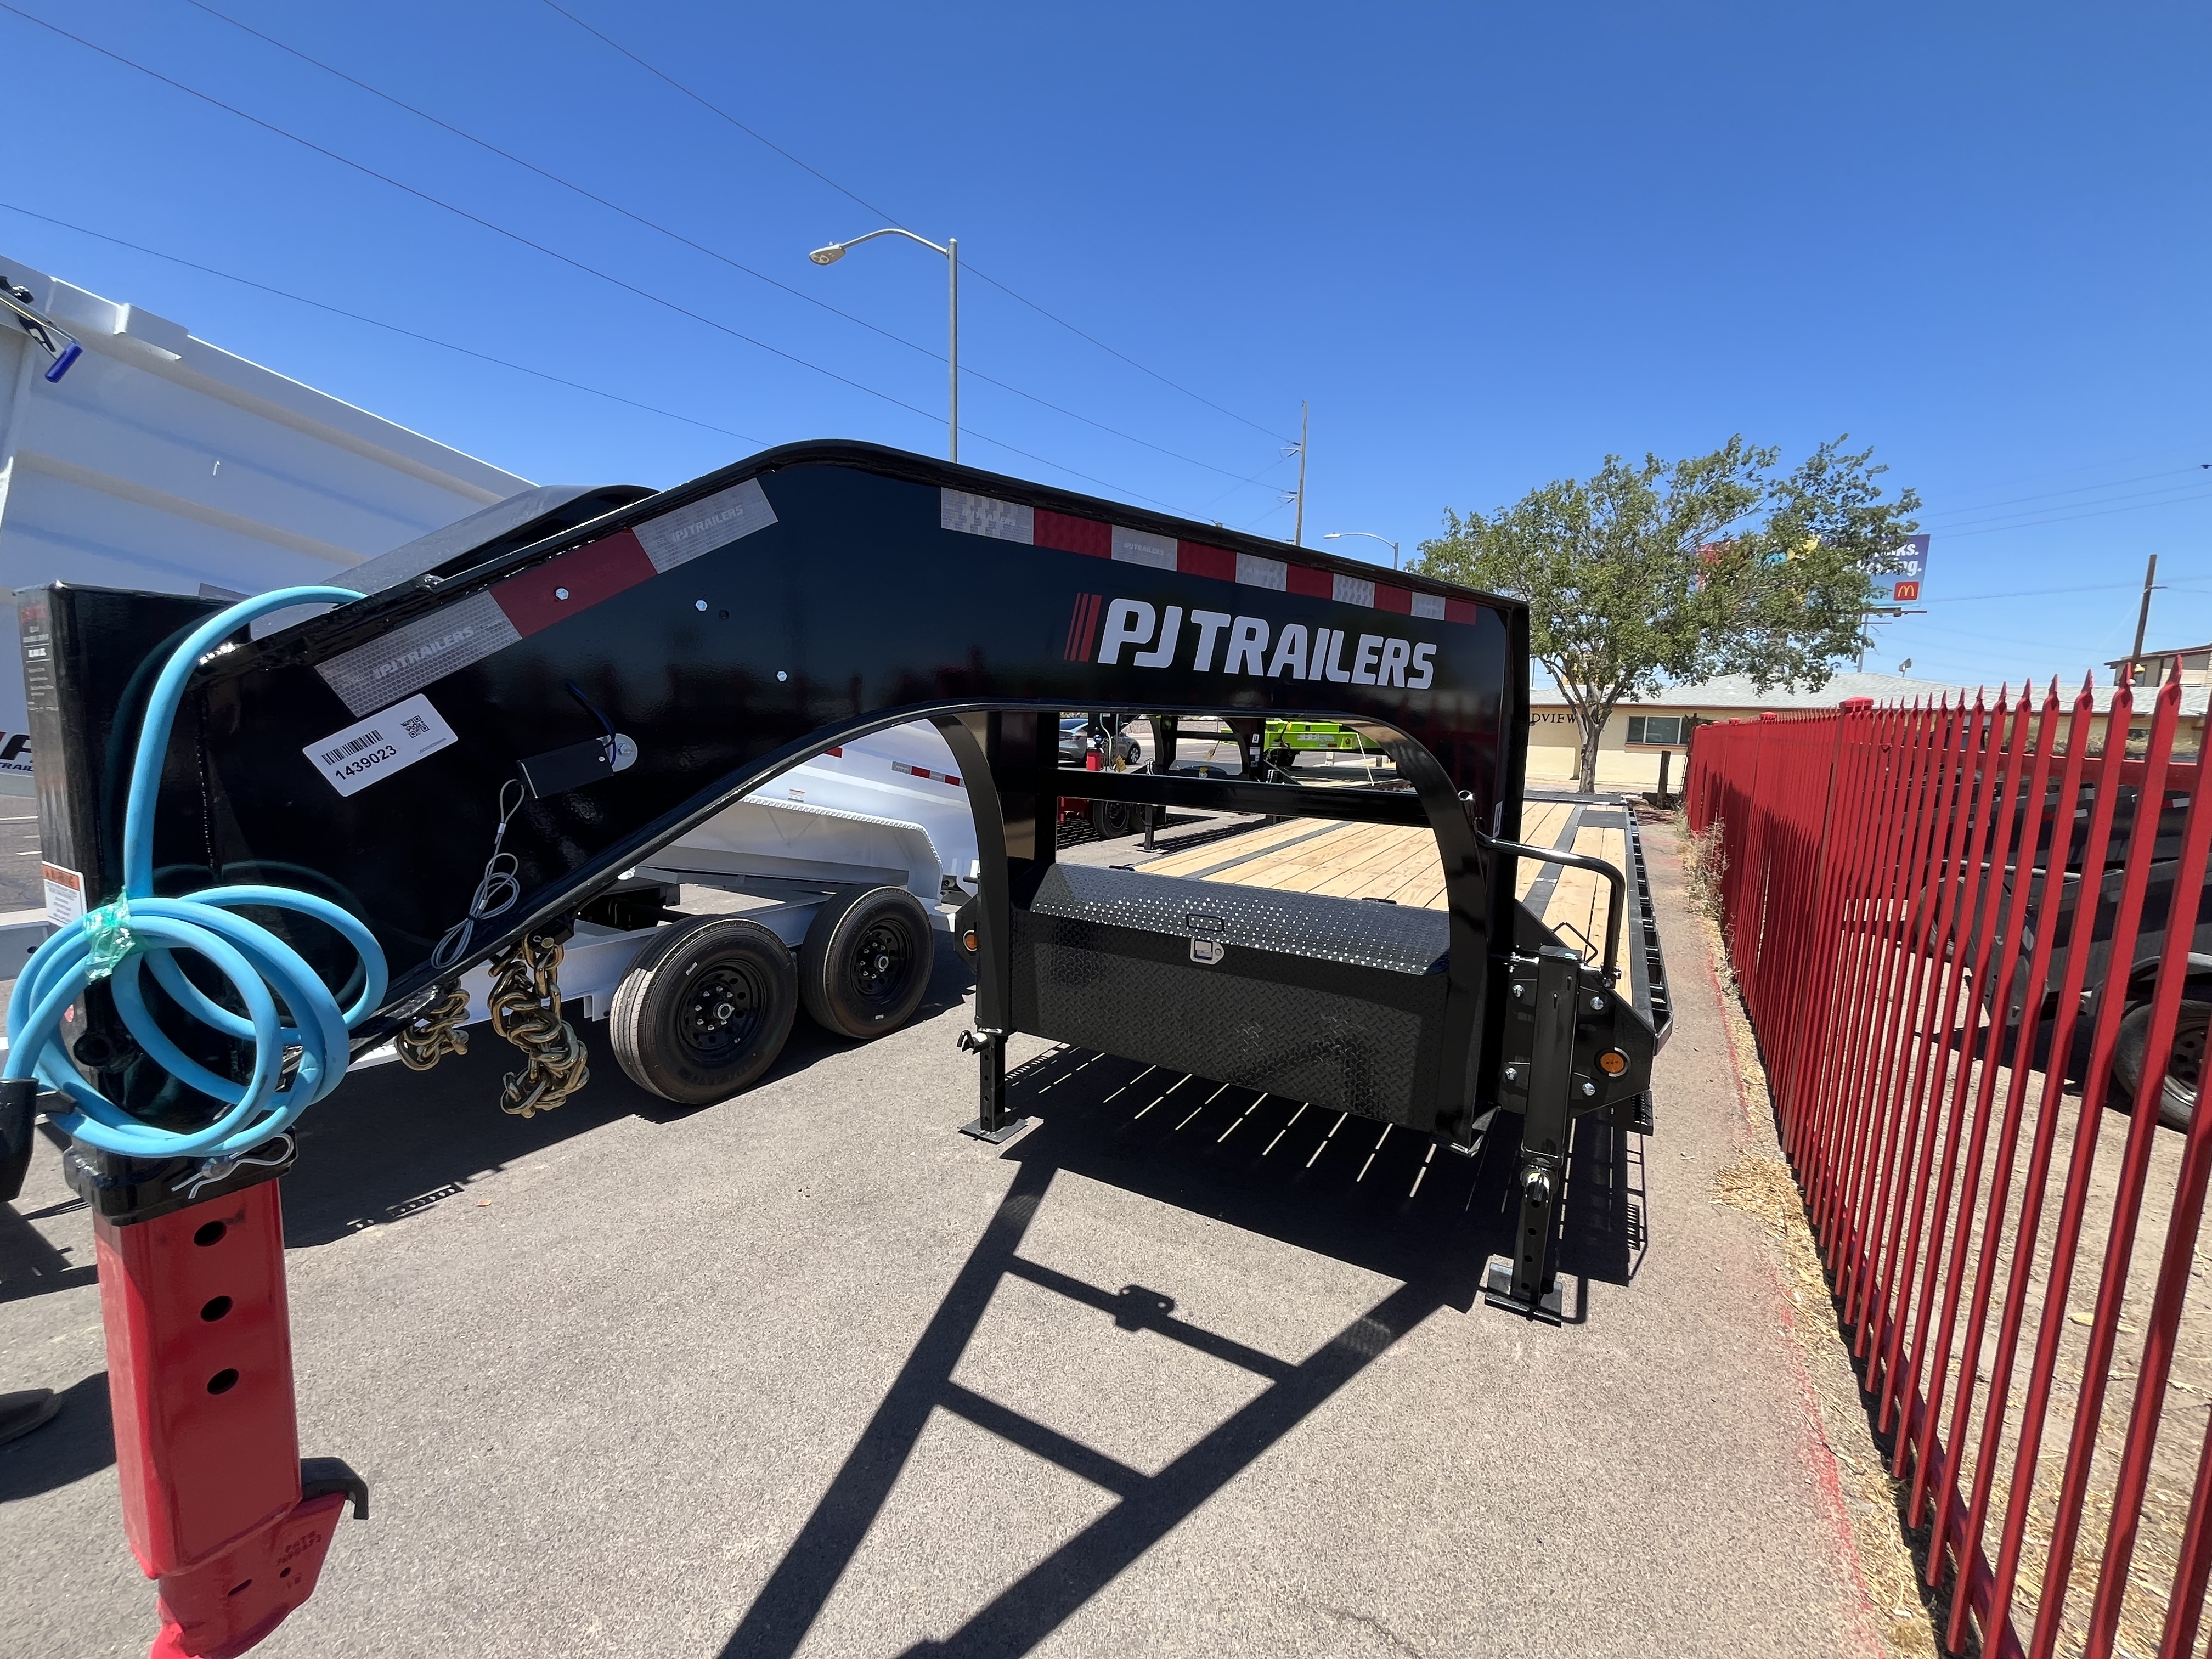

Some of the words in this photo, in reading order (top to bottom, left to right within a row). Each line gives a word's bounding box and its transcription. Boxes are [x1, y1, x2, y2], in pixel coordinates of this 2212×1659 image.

[687, 505, 743, 534] TRAILERS
[397, 625, 474, 668] TRAILERS
[1098, 598, 1182, 668] PJ
[1190, 609, 1437, 689] TRAILERS
[1532, 713, 1576, 724] DVIEW
[335, 745, 397, 780] 1439023
